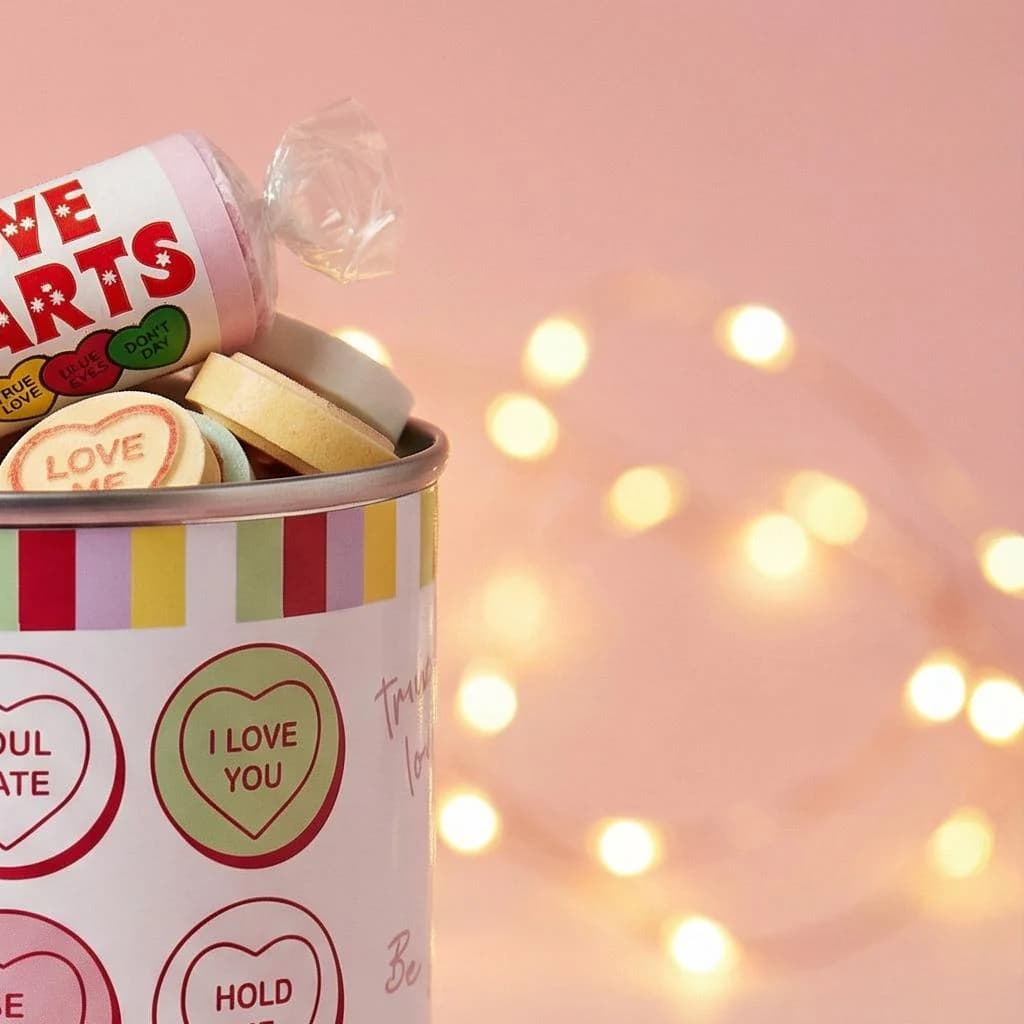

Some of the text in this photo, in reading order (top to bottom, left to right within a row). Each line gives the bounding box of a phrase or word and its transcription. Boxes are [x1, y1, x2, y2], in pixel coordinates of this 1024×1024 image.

[2, 386, 43, 414] LOVE
[45, 432, 145, 481] LOVE
[209, 721, 298, 755] I LOVE
[223, 762, 282, 792] YOU
[216, 978, 293, 1012] HOLD
